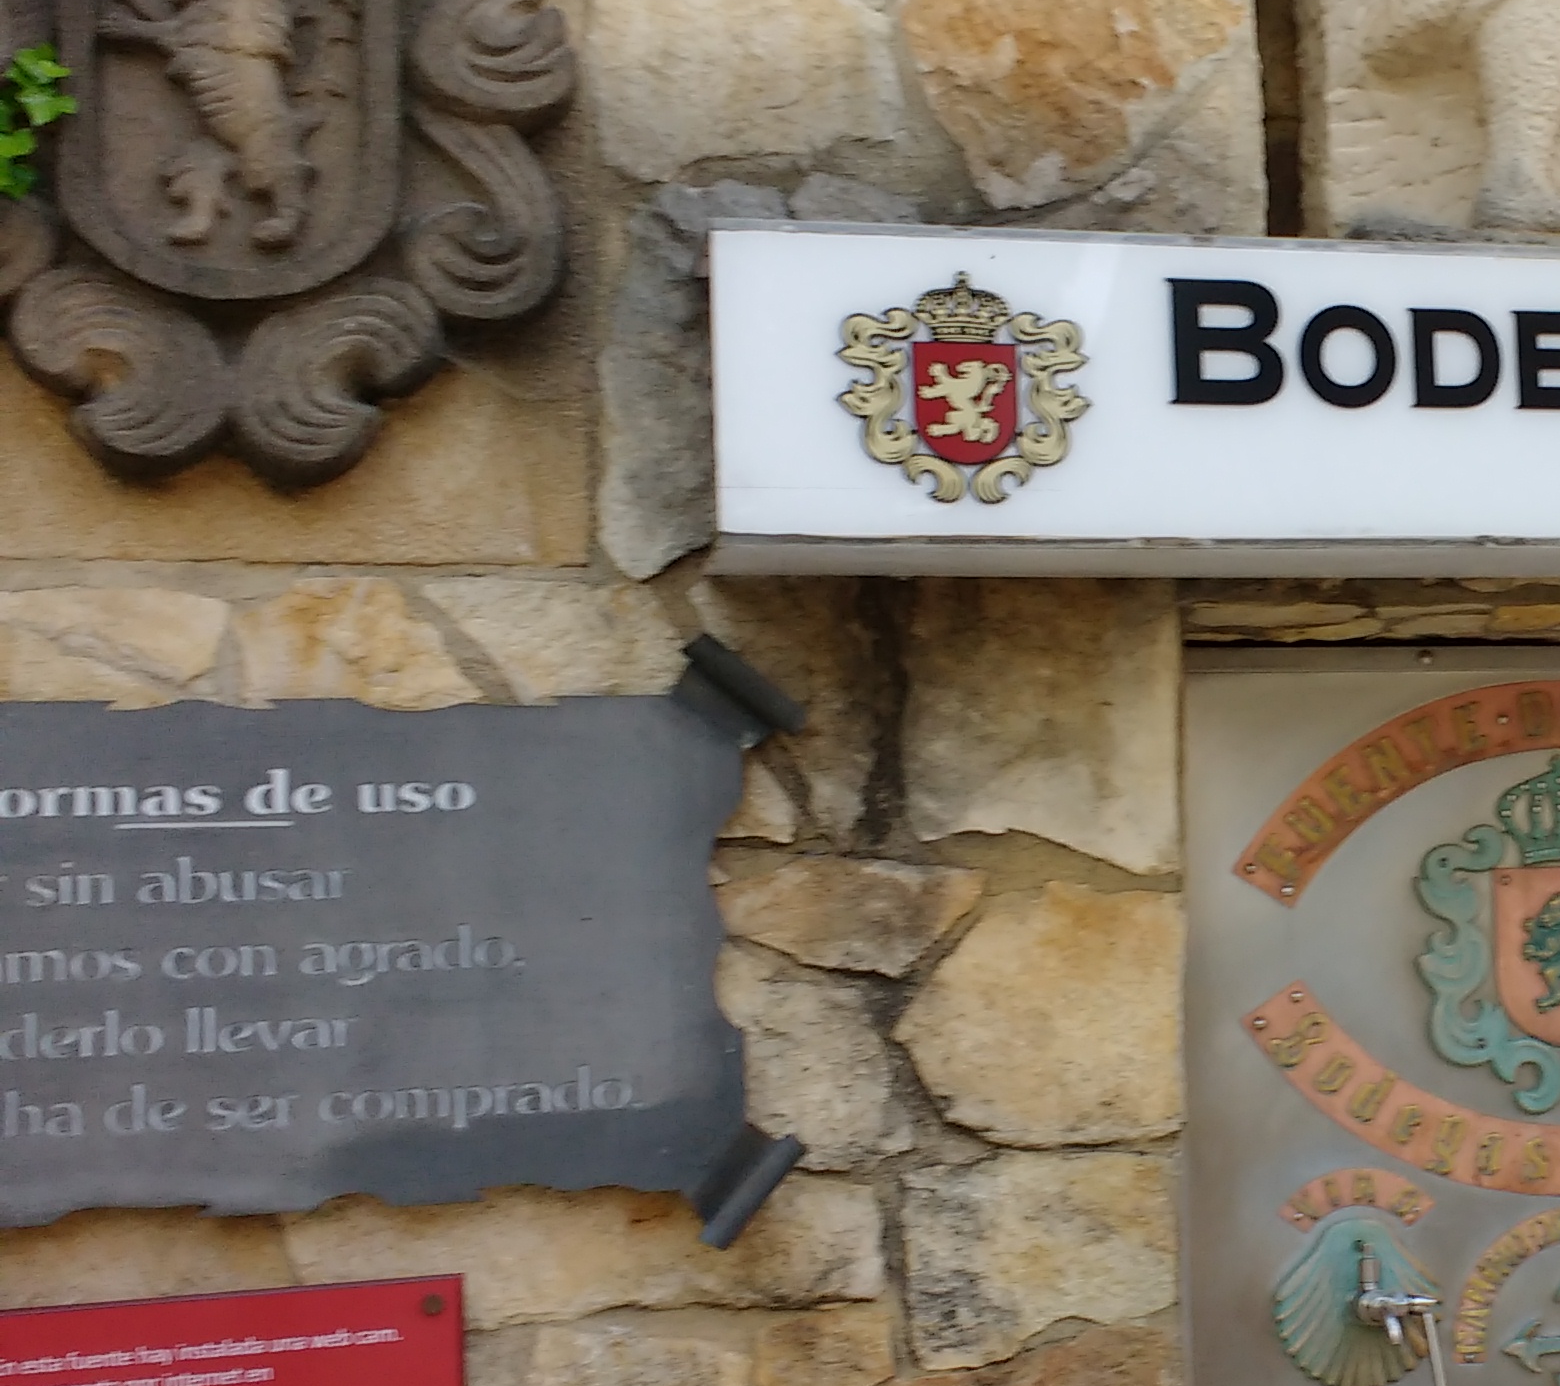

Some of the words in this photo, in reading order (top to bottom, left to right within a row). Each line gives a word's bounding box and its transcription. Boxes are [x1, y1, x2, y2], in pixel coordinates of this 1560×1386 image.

[244, 766, 335, 815] de
[356, 779, 478, 814] uso
[24, 860, 116, 907] sin
[136, 855, 354, 905] abusar
[160, 943, 278, 979] con
[299, 922, 527, 986] agrado.
[184, 1005, 360, 1054] llevar
[3, 1088, 84, 1138] ha
[103, 1082, 189, 1133] de
[206, 1094, 301, 1131] ser
[318, 1063, 649, 1130] comprado.
[1267, 1011, 1551, 1182] Bodegas
